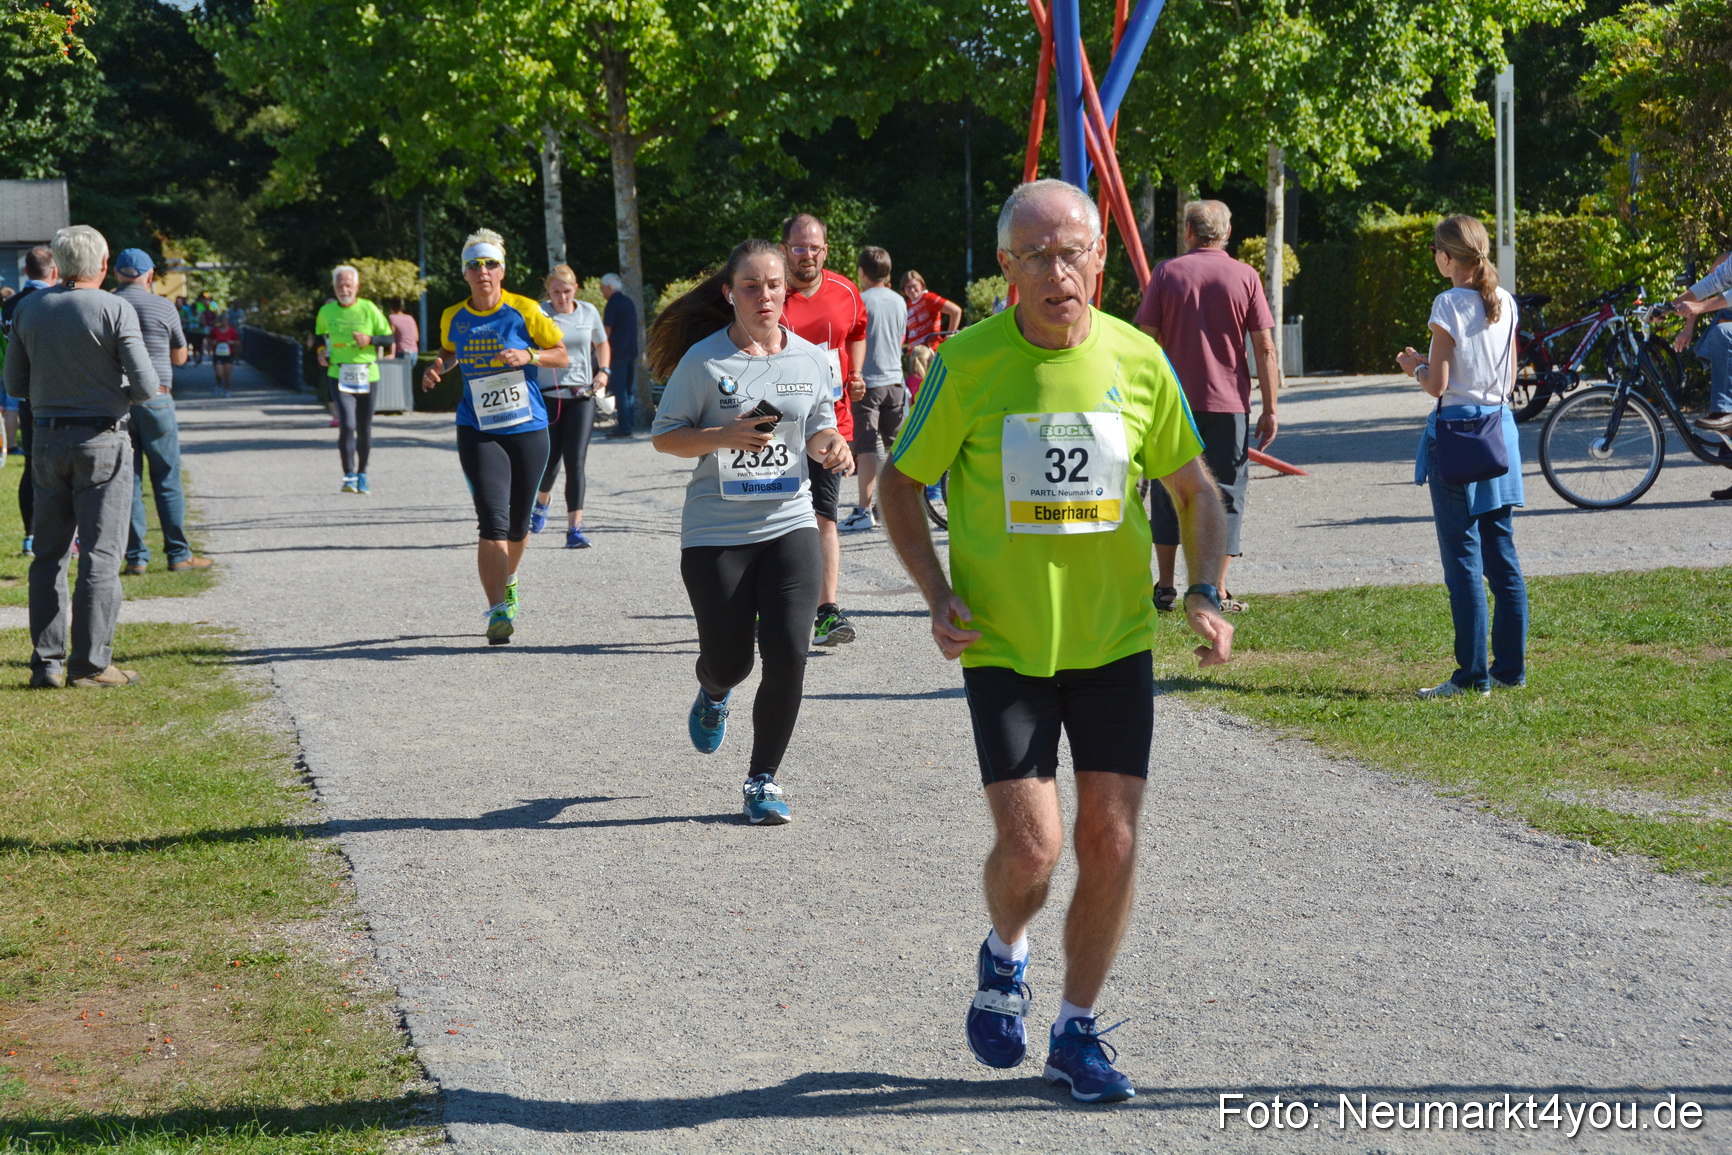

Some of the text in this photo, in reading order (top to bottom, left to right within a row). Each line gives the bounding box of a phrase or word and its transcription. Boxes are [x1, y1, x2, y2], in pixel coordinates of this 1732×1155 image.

[776, 383, 813, 393] BOCK
[481, 386, 520, 408] 2215
[492, 412, 517, 423] Claudia
[1040, 425, 1094, 437] BOCK
[730, 444, 789, 469] 2323
[1045, 447, 1089, 483] 32
[742, 482, 782, 492] Vanessa
[1035, 505, 1098, 520] Eberhard
